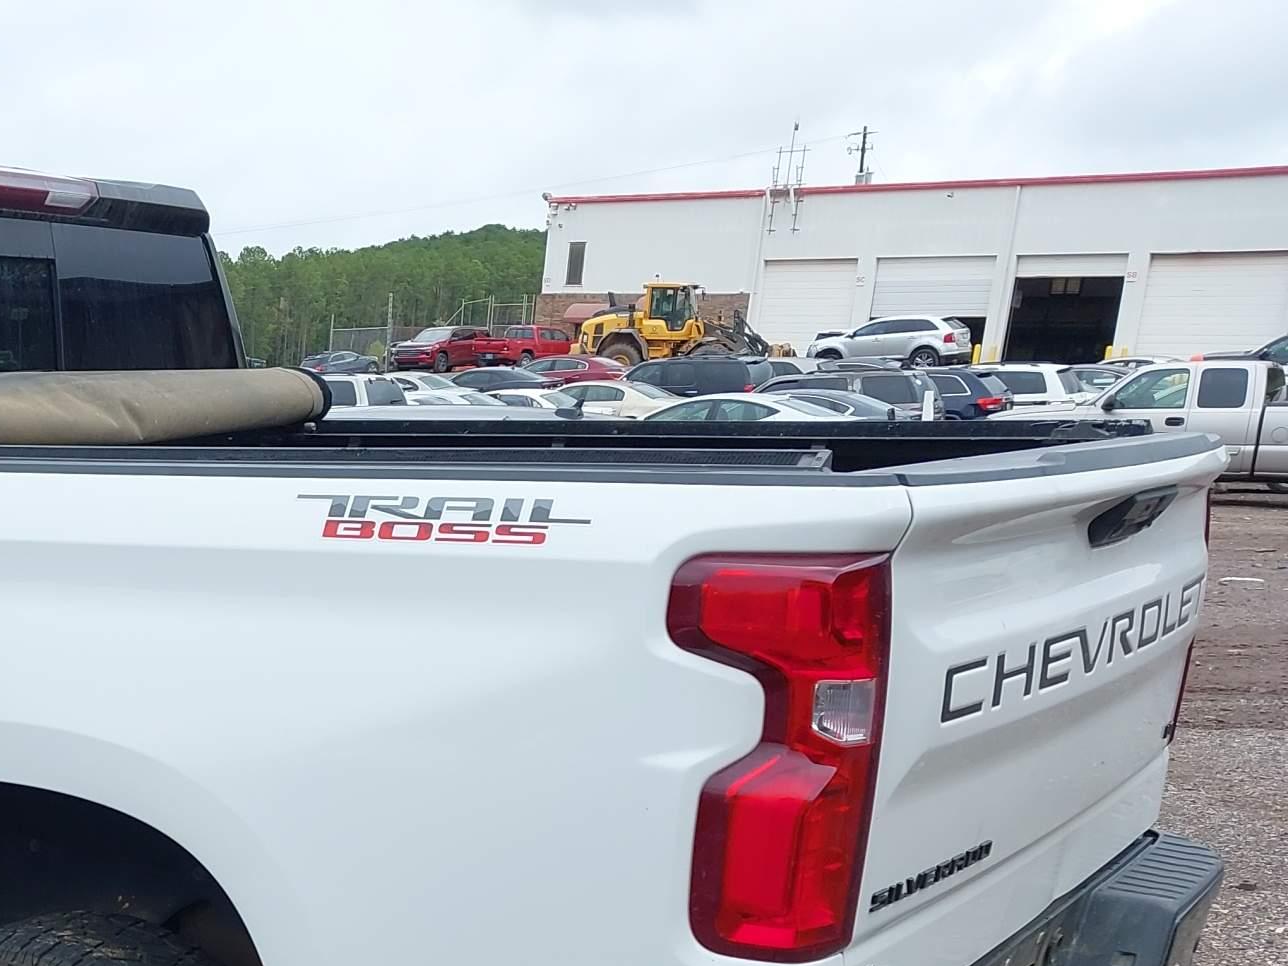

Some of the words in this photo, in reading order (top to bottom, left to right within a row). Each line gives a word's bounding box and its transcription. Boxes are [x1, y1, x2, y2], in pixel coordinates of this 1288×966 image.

[297, 494, 591, 525] TRAIL
[322, 519, 549, 545] BOSS
[940, 573, 1206, 723] CHEVROLET
[868, 839, 993, 913] SILVERADO
